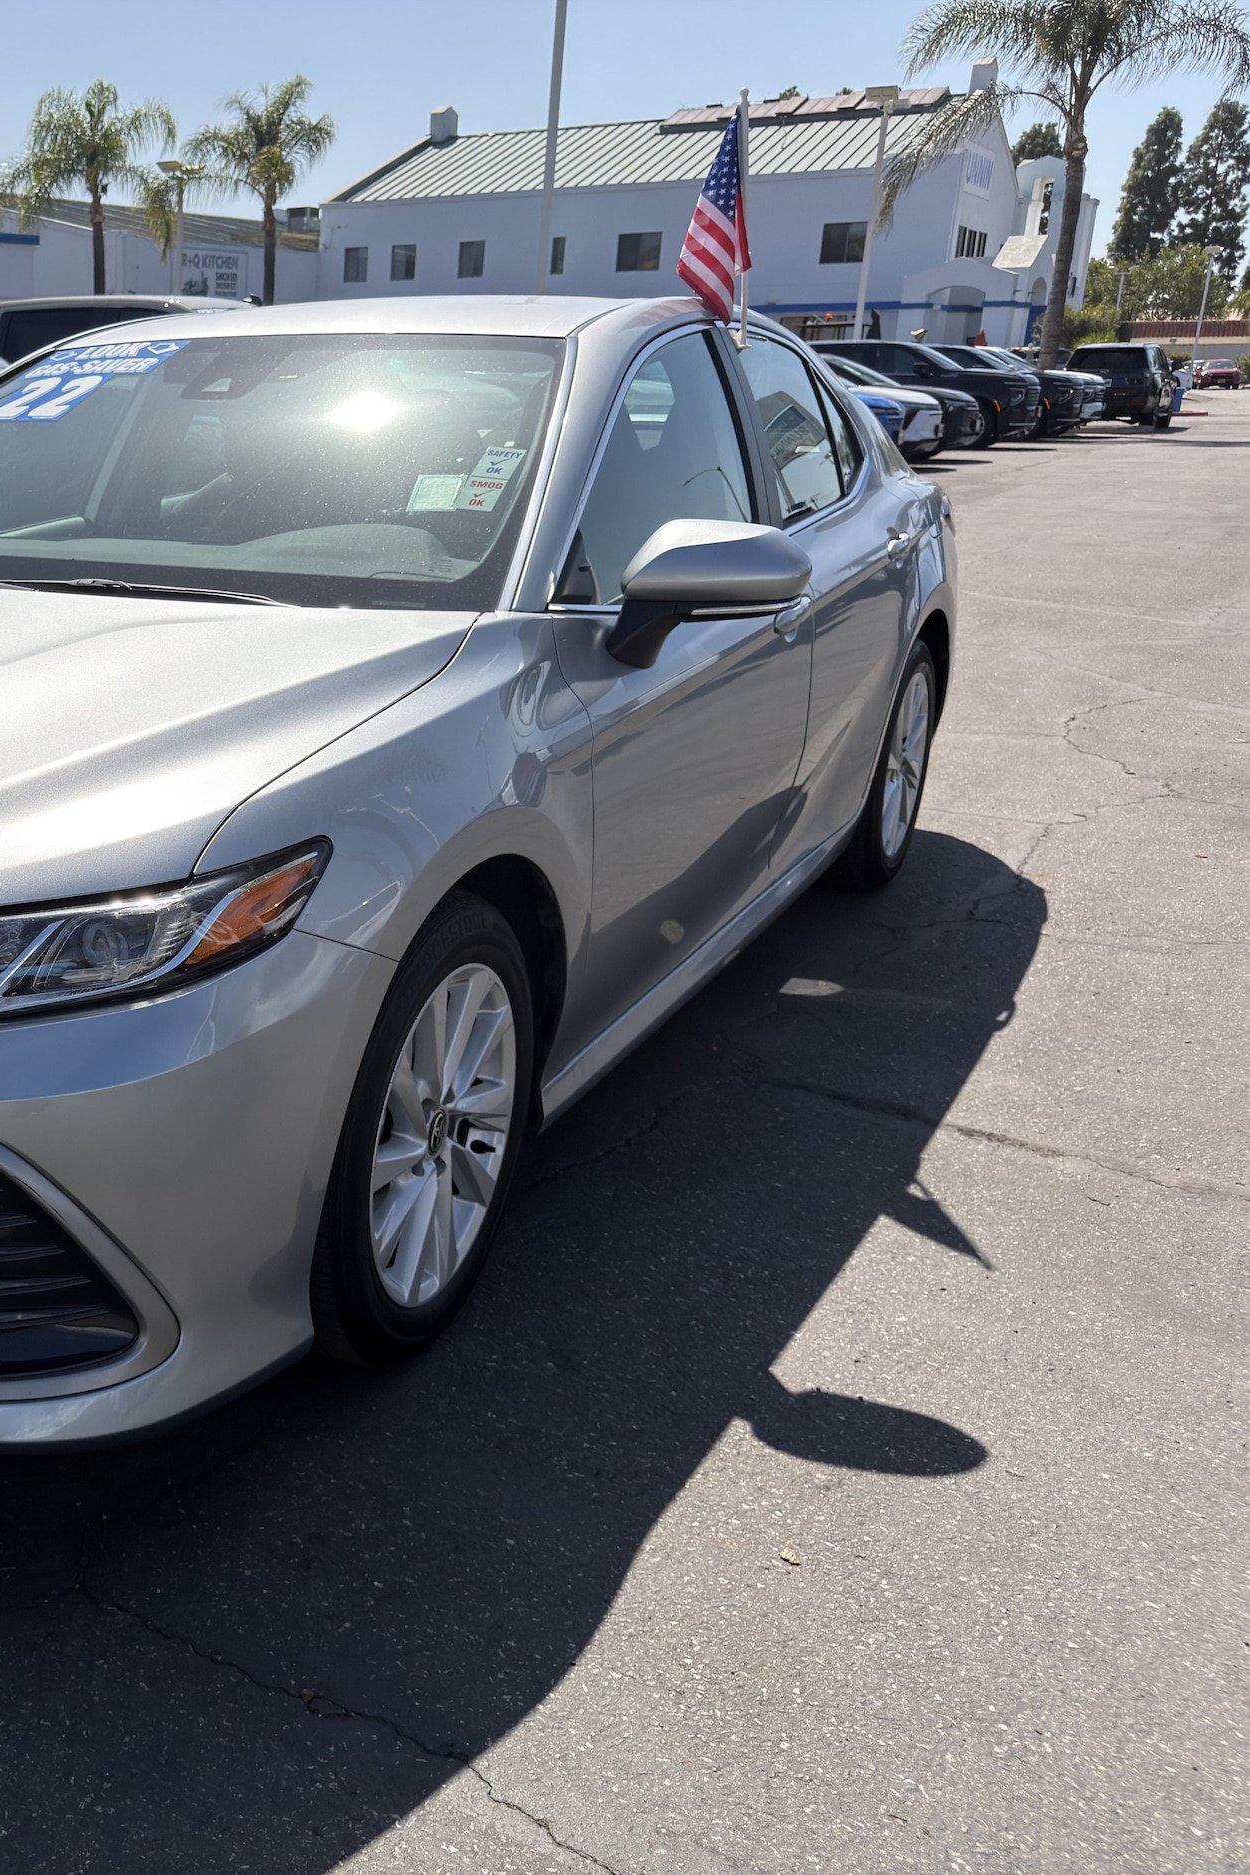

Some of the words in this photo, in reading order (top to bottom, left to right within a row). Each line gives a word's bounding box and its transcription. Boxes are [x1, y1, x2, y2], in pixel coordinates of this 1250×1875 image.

[201, 254, 238, 270] KITCHEN
[75, 342, 148, 360] LOOK
[487, 450, 522, 459] SAFETY
[486, 467, 503, 475] OK
[469, 481, 504, 490] SMOG
[468, 499, 485, 507] OK
